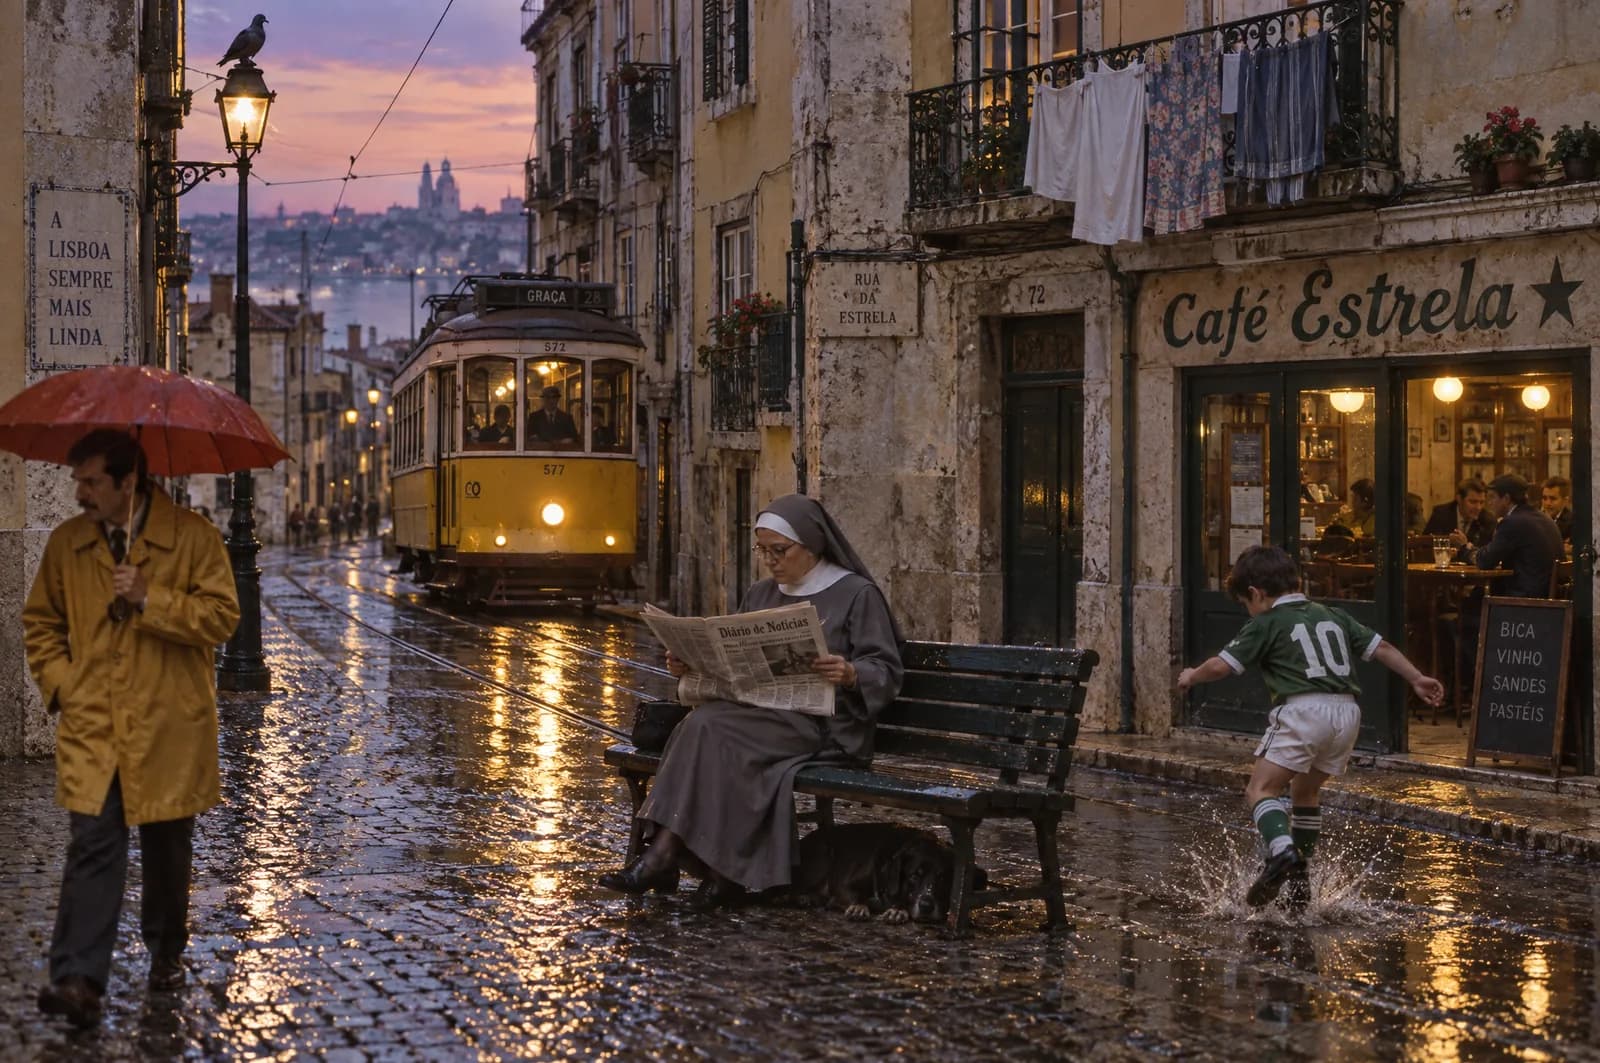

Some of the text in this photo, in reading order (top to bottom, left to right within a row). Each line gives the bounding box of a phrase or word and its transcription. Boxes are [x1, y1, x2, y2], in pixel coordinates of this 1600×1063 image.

[51, 211, 62, 229] A
[49, 240, 111, 260] LISBOA
[49, 269, 113, 289] SEMPRE
[855, 273, 881, 286] RUA
[527, 289, 567, 304] GRAÇA
[860, 292, 877, 305] DA
[1028, 284, 1045, 305] 72
[49, 298, 92, 317] MAIS
[1163, 257, 1518, 357] Café Estrela
[839, 311, 897, 324] ESTRELA
[49, 327, 103, 346] LINDA
[543, 464, 565, 476] 577
[718, 625, 751, 639] Diário
[753, 623, 765, 634] de
[1500, 621, 1535, 639] BICA
[1290, 621, 1350, 679] 10
[1497, 648, 1542, 666] VINHO
[1492, 675, 1546, 694] SANDES
[1489, 701, 1545, 722] PASTÉIS
